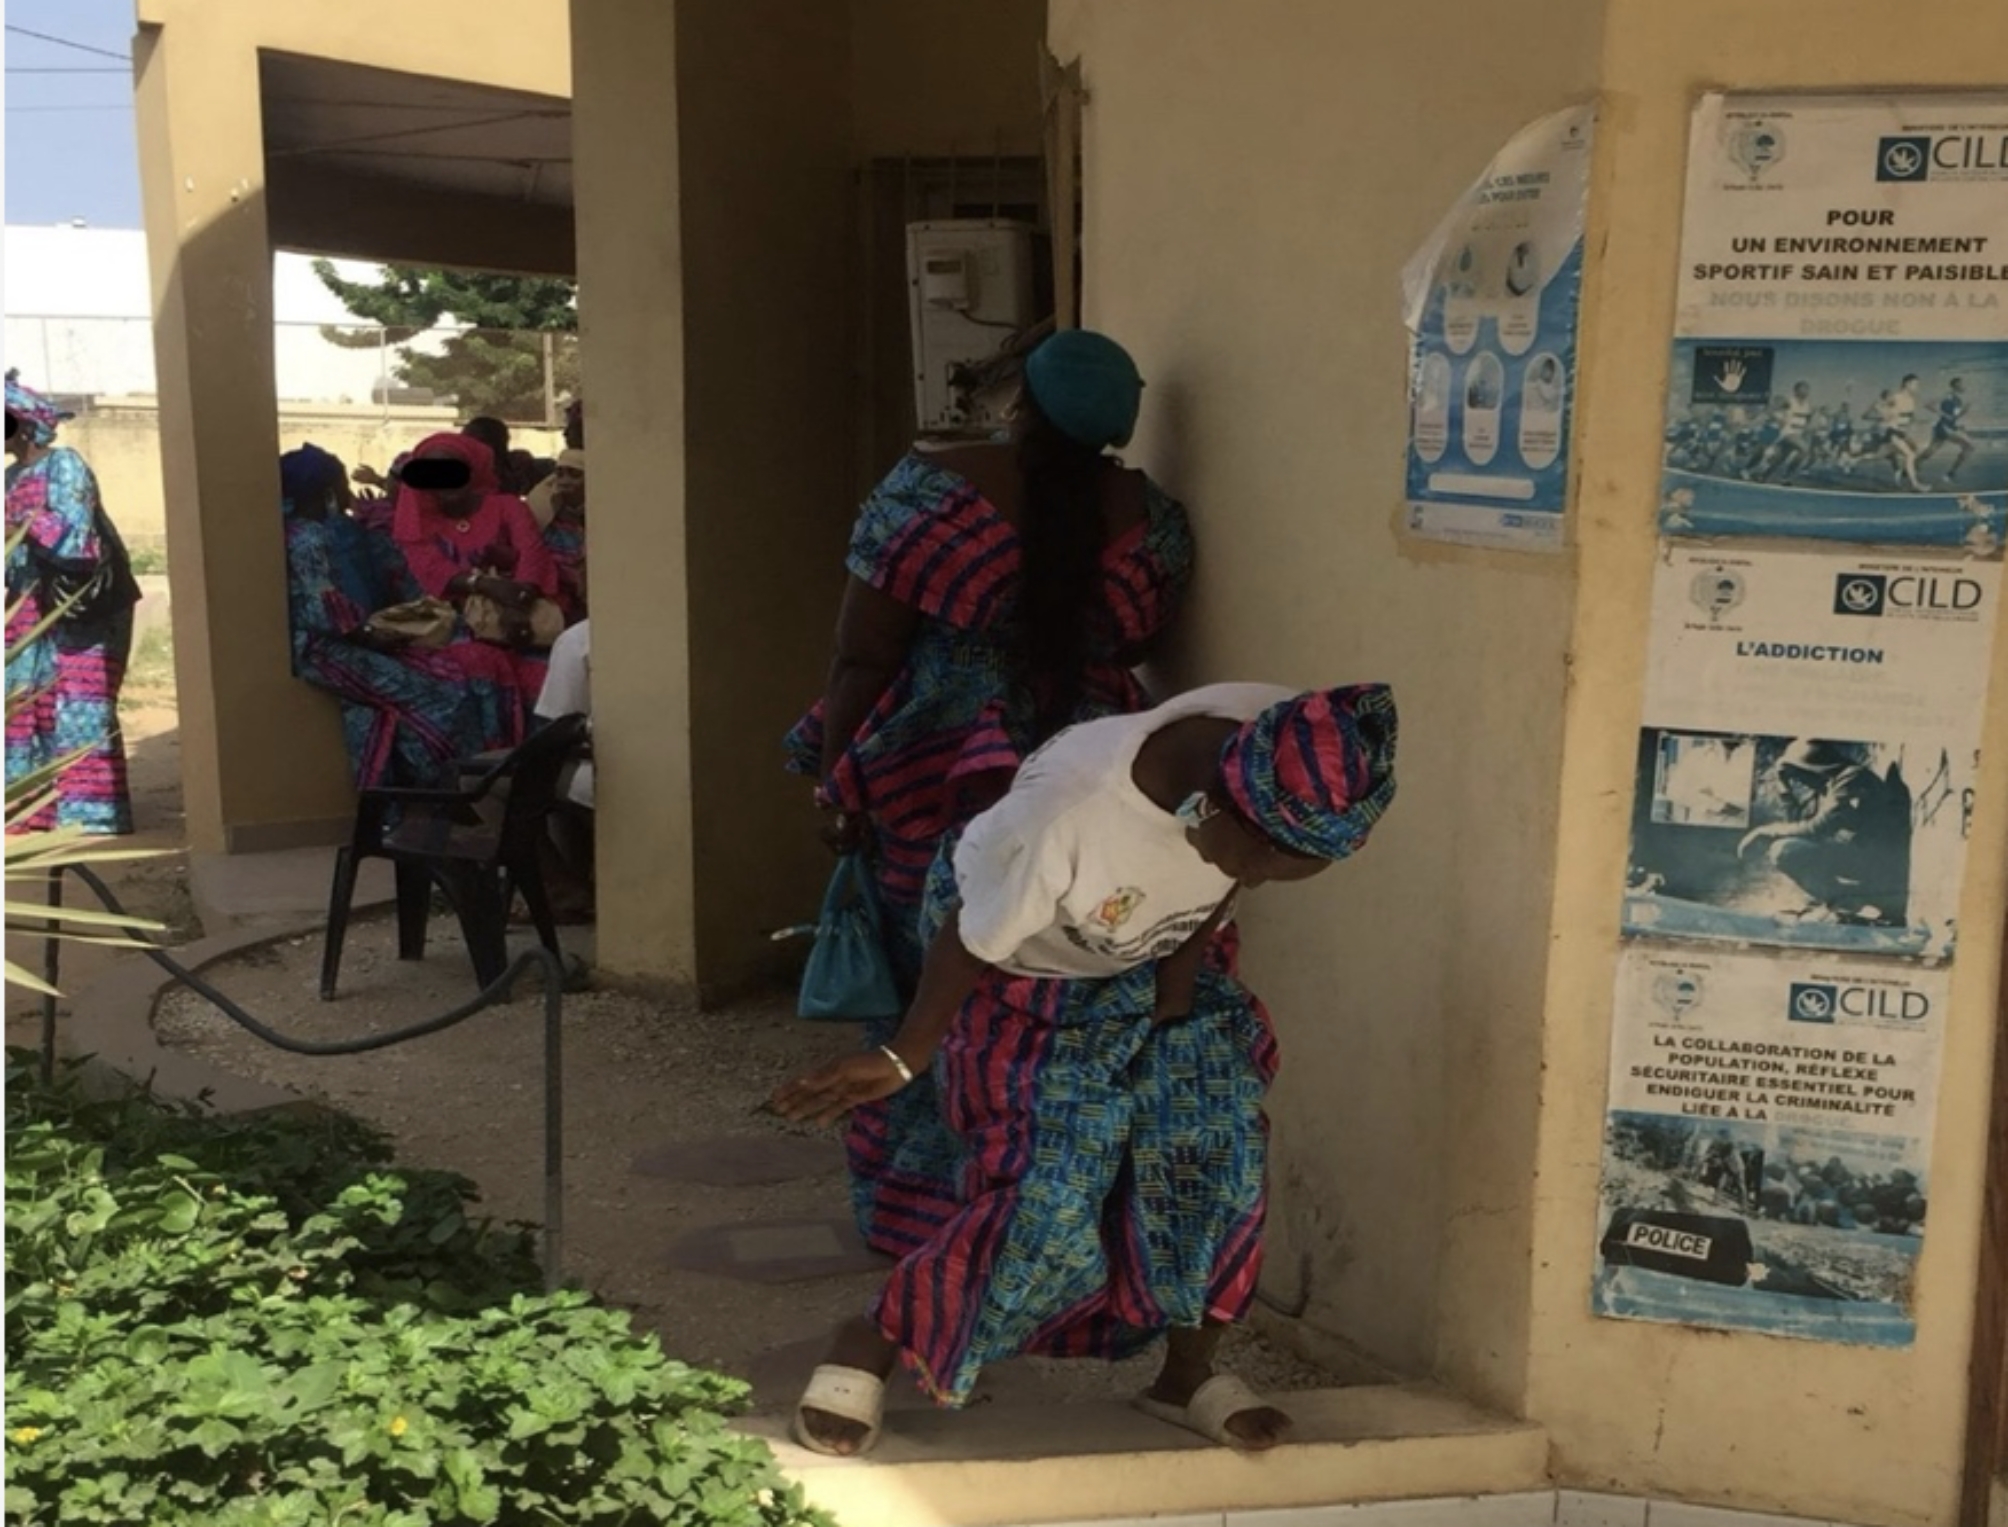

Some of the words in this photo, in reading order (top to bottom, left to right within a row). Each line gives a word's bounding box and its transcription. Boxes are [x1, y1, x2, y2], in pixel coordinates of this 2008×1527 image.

[1826, 210, 1894, 226] POUR
[1731, 237, 1766, 253] UN
[1774, 237, 1988, 253] ENVIRONNEMENT
[1693, 263, 1794, 281] SPORTIF
[1801, 263, 1859, 281] SAIN
[1867, 264, 1898, 280] ET
[1710, 291, 1777, 308] NOUS
[1785, 291, 1874, 308] DISONS
[1882, 292, 1936, 308] NON
[1968, 293, 1999, 308] LA
[1800, 318, 1901, 335] DROGUE
[1888, 576, 1982, 610] CILD
[1736, 641, 1885, 664] L'ADDICTION
[1840, 986, 1929, 1021] CILD
[1654, 1034, 1676, 1048] LA
[1681, 1037, 1837, 1062] COLLABORATION
[1842, 1050, 1868, 1064] DE
[1872, 1052, 1896, 1066] LA
[1646, 1083, 1741, 1103] ENDIGUER
[1746, 1092, 1769, 1106] LA
[1756, 1075, 1856, 1096] ESSENTIEL
[1863, 1086, 1916, 1102] POUR
[1744, 1107, 1768, 1121] LA
[1634, 1225, 1706, 1255] POLICE
